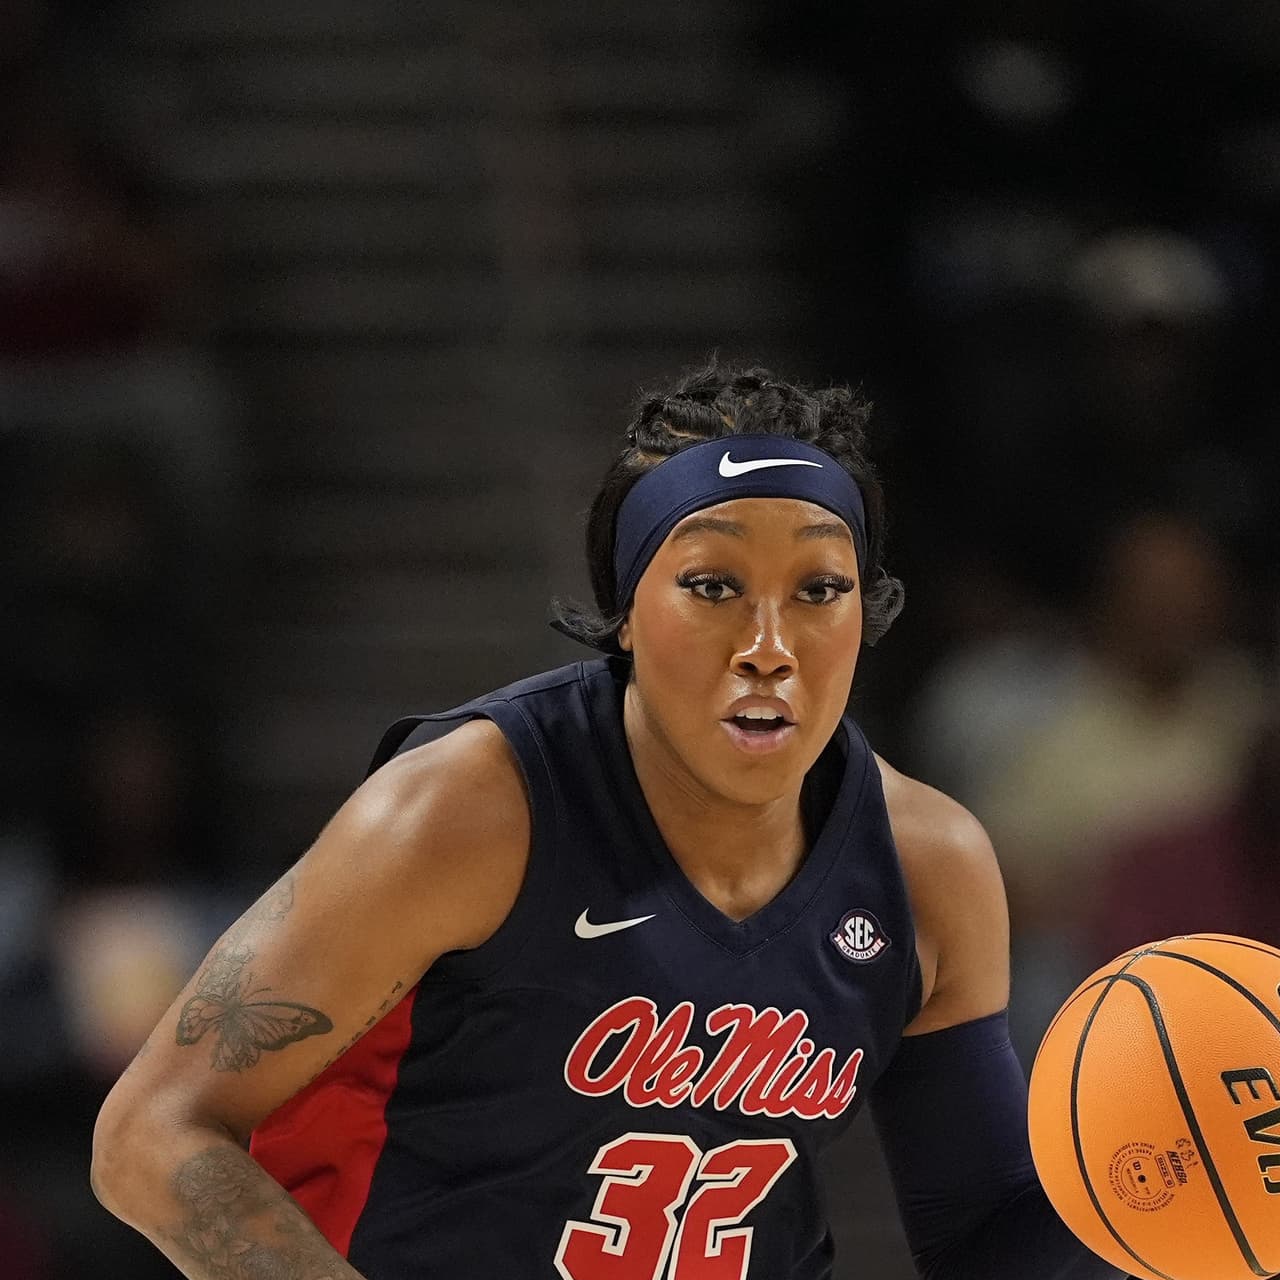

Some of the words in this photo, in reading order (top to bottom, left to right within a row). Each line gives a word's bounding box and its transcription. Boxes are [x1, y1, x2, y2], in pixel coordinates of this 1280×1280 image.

[844, 916, 874, 950] SEC
[564, 996, 705, 1109] Ole
[691, 1003, 864, 1120] Miss
